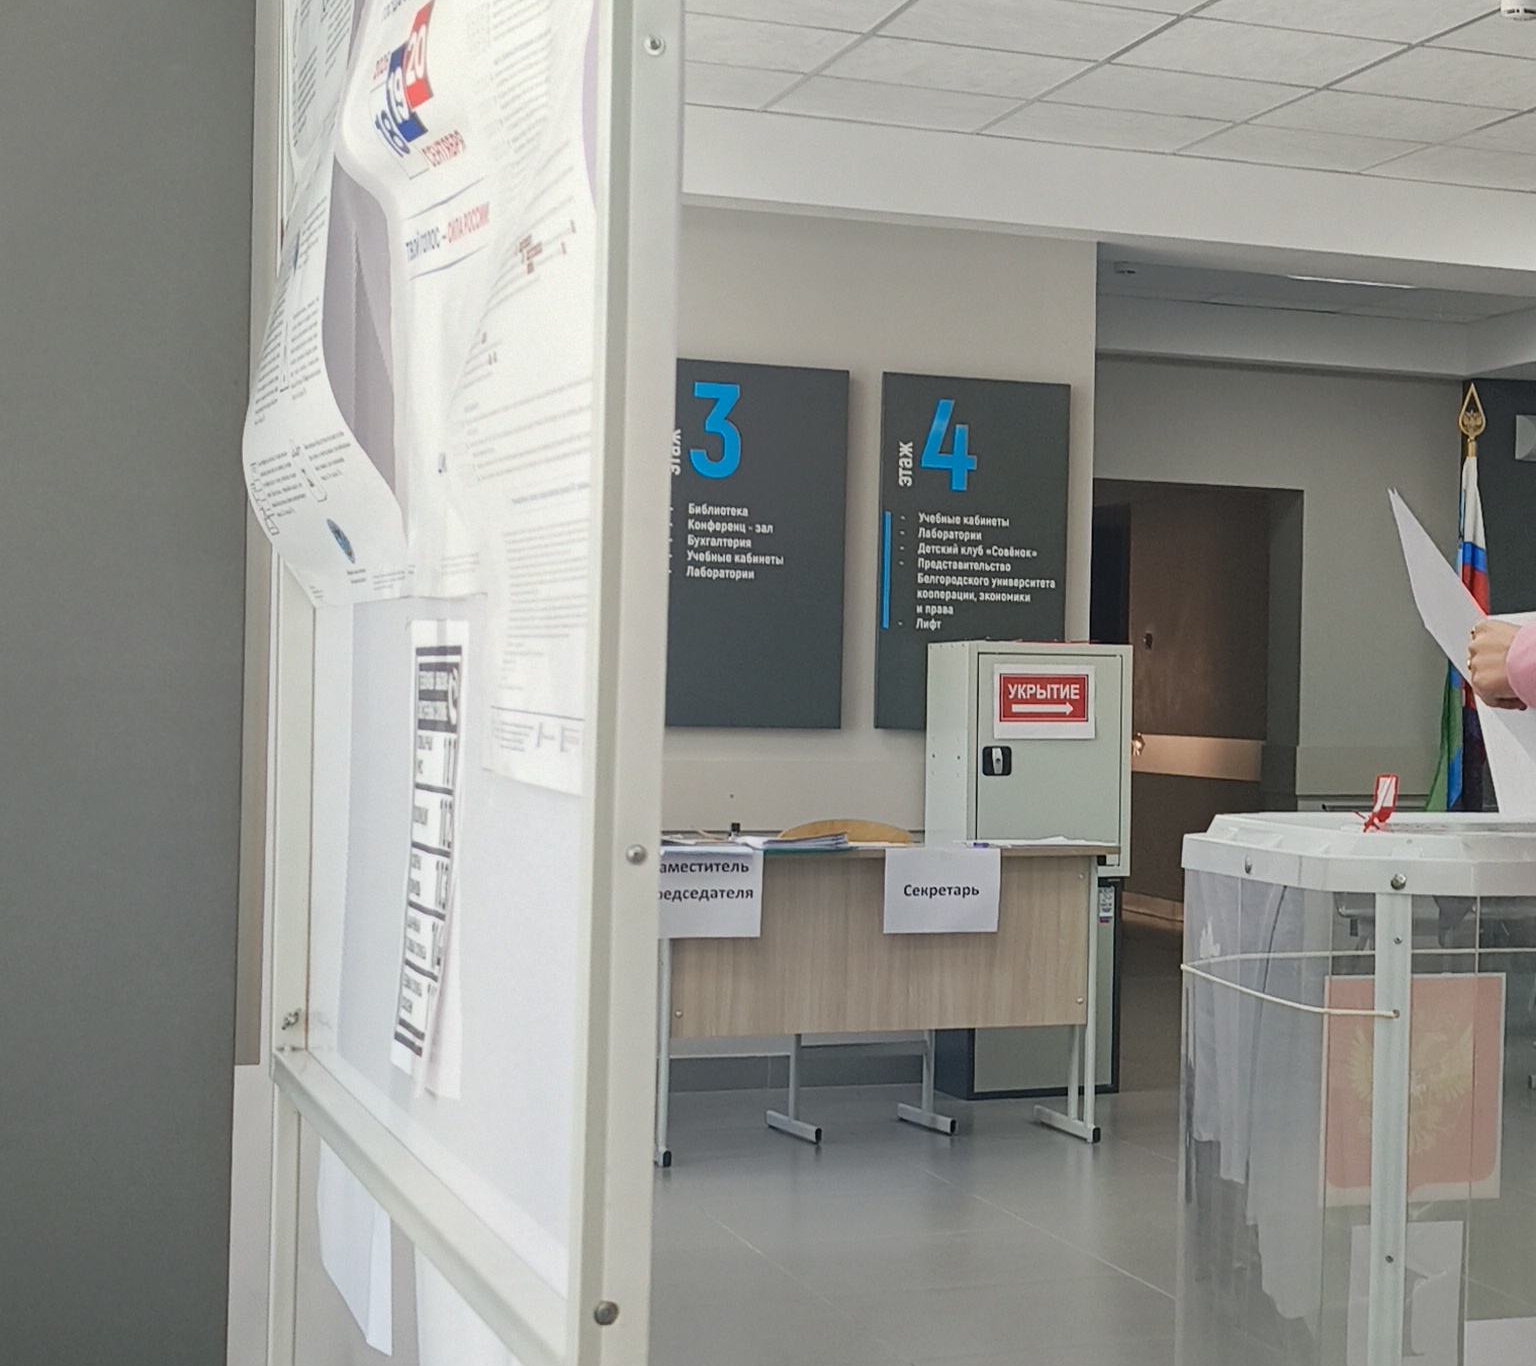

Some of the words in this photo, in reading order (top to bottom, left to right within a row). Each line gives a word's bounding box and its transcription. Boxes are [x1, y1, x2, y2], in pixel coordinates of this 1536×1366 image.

[405, 25, 426, 87] 20
[387, 66, 410, 124] 19
[374, 109, 411, 158] 18
[421, 130, 467, 168] СЕНТЯБРЯ
[688, 382, 742, 479] 3
[921, 399, 977, 491] 4
[898, 441, 913, 487] этаж
[688, 503, 749, 517] Библиотека
[688, 519, 746, 534] Конференц
[755, 524, 773, 534] зал
[918, 512, 961, 526] Учебные
[963, 515, 1010, 528] кабинеты
[687, 534, 752, 550] Бухгалтерия
[918, 527, 982, 542] Лаборатории
[687, 550, 732, 564] Учебные
[734, 552, 784, 565] кабинеты
[917, 543, 959, 557] Детский
[960, 543, 984, 557] клуб
[686, 565, 755, 580] Лаборатории
[918, 558, 1011, 572] Представительство
[917, 572, 990, 588] Белгородского
[991, 576, 1055, 590] университета
[917, 590, 977, 602] кооперации,
[979, 592, 1031, 602] экономики
[916, 605, 923, 614] и
[925, 604, 954, 615] права
[916, 618, 941, 631] Лифт
[1007, 683, 1080, 701] УКРЫТИЕ
[660, 862, 750, 874] аместитель
[659, 889, 754, 903] едседателя
[903, 883, 980, 900] Секретарь
